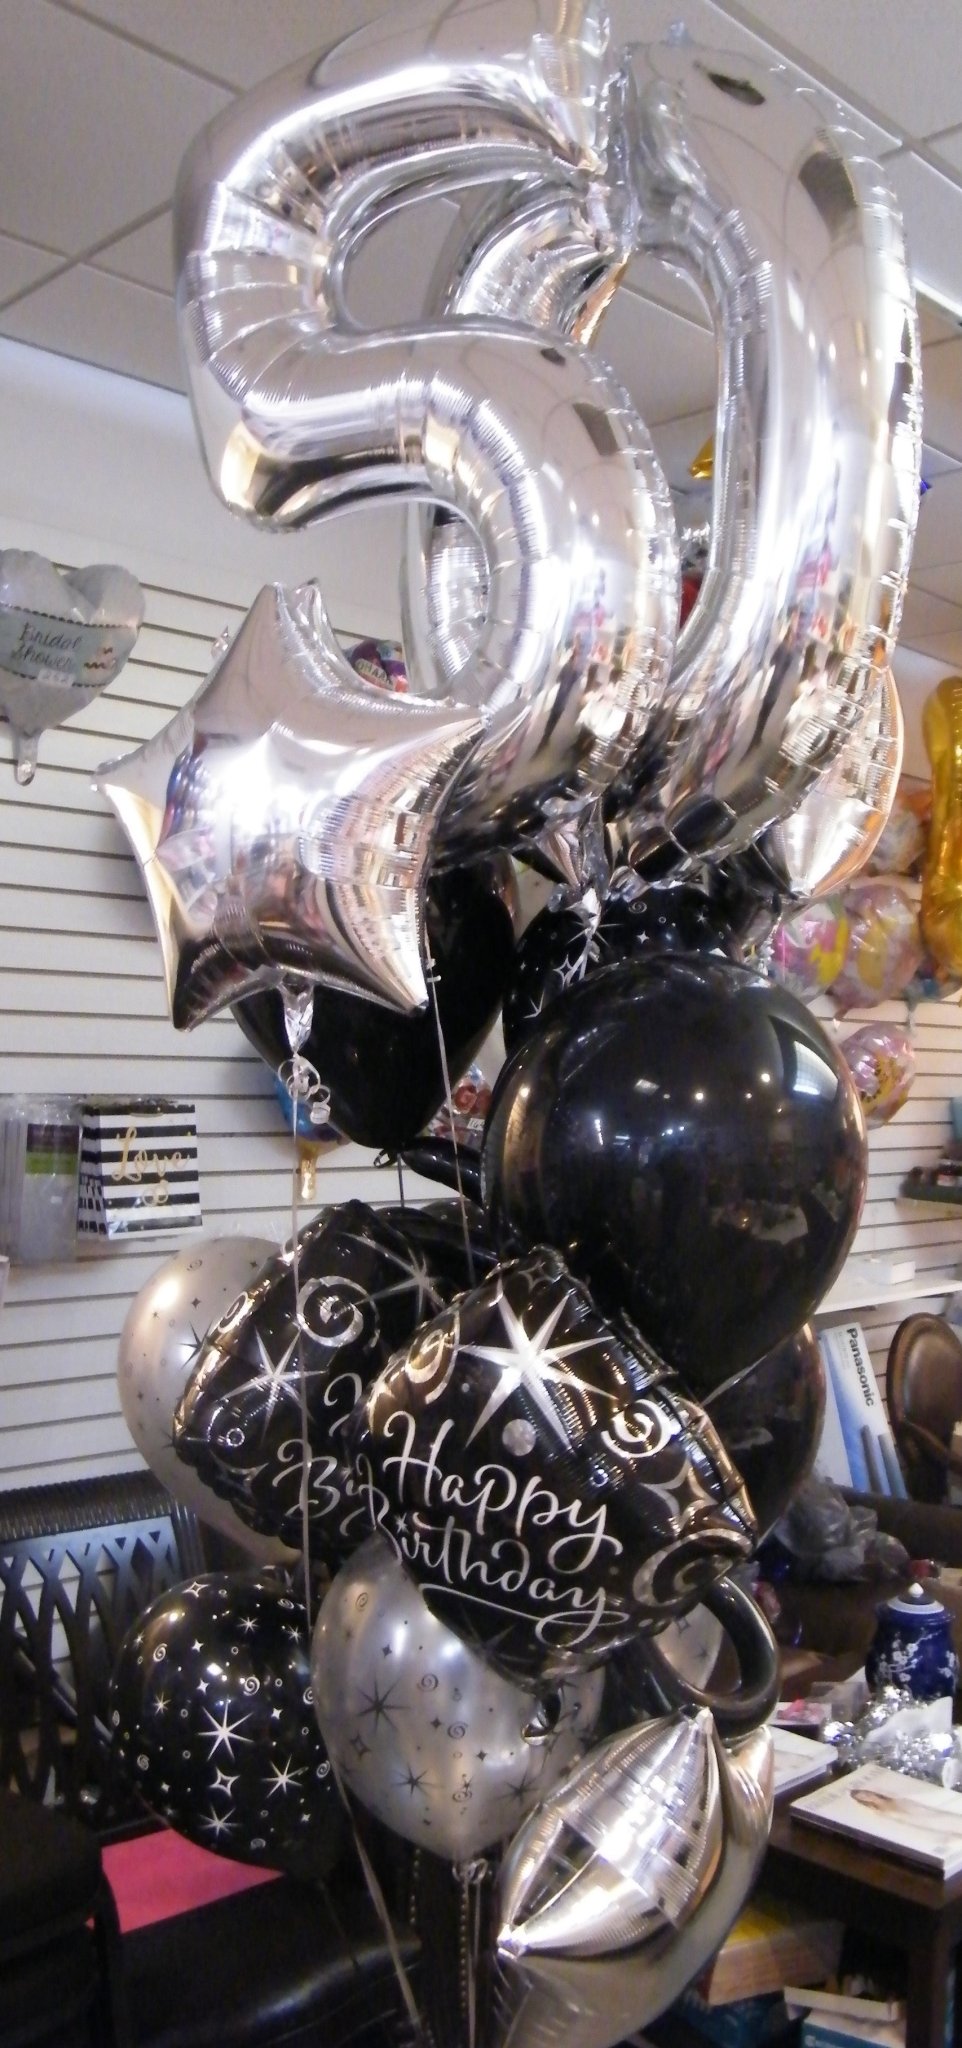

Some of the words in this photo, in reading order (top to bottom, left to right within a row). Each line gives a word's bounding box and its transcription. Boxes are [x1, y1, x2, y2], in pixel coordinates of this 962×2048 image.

[11, 643, 72, 669] Shower
[19, 622, 82, 650] Bridal
[112, 1126, 191, 1207] Love
[846, 1327, 875, 1407] Panasonic
[382, 1410, 624, 1574] Happy
[340, 1453, 630, 1648] Birthday
